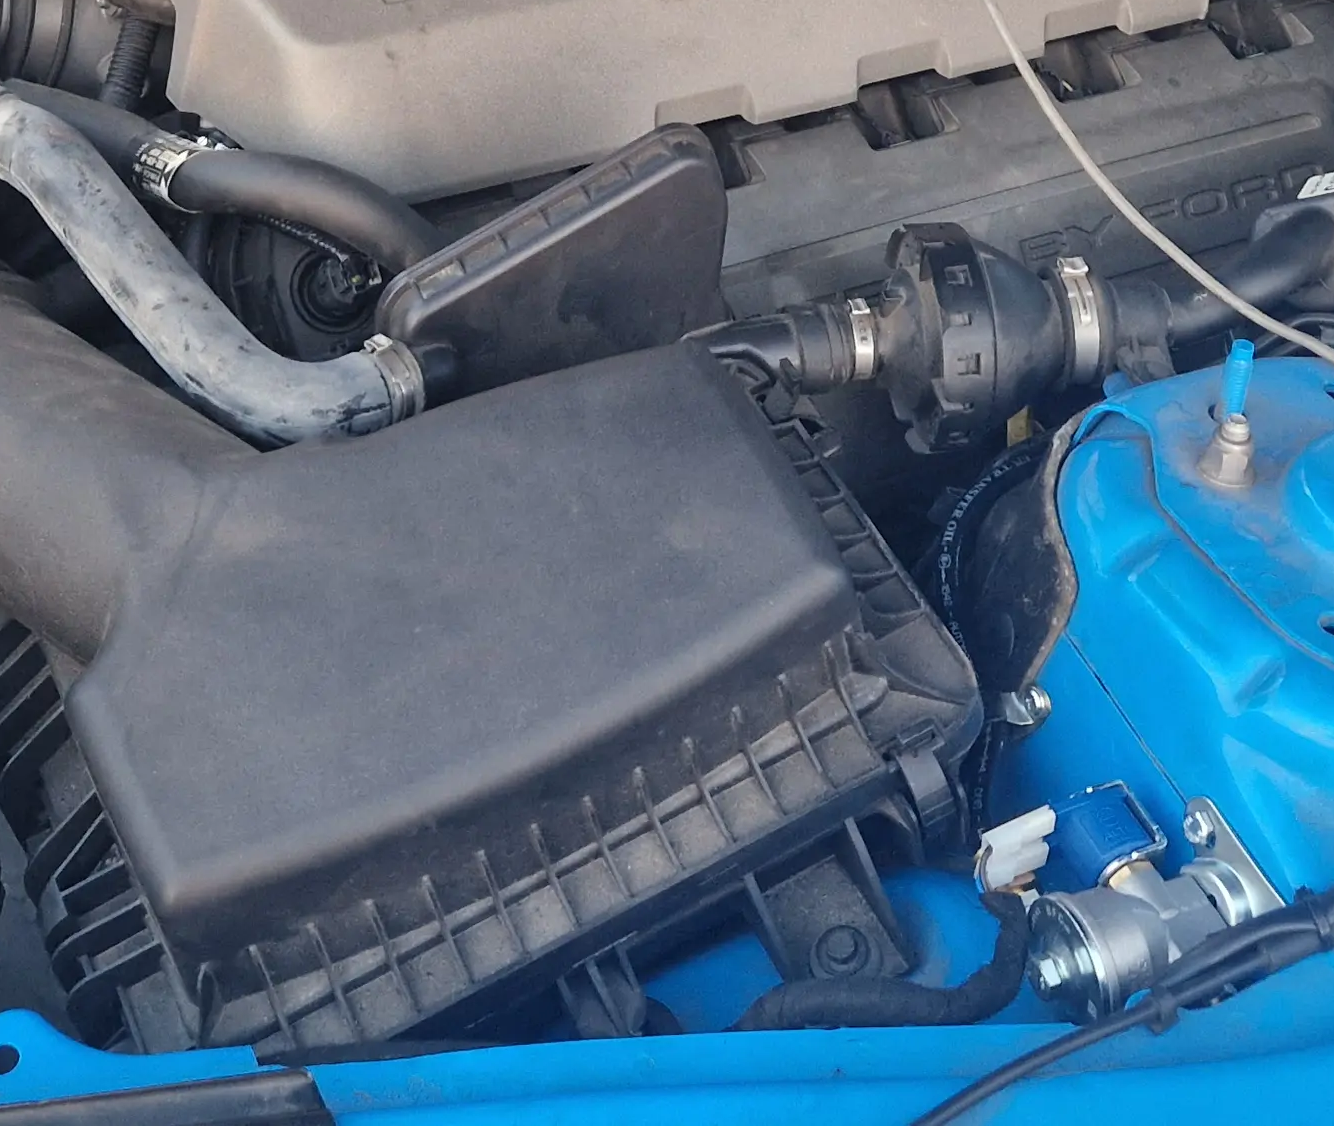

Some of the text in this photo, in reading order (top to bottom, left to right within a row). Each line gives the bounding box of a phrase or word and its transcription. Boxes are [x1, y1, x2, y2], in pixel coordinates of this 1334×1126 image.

[1019, 214, 1116, 265] BY
[951, 463, 1012, 518] TRANSFER
[941, 522, 957, 545] OIL
